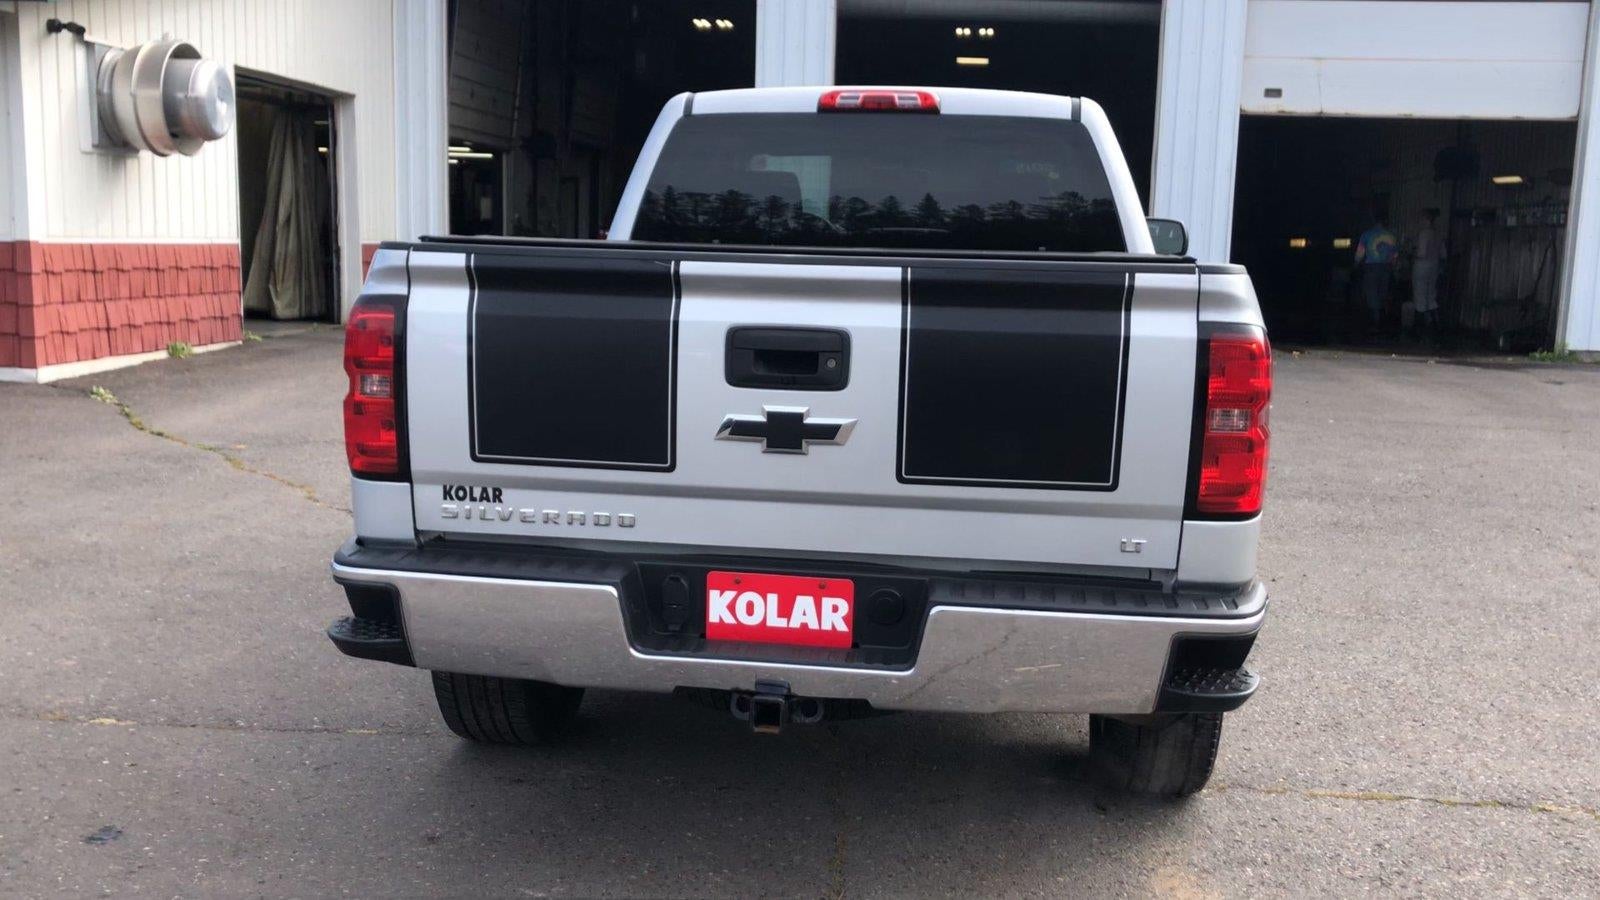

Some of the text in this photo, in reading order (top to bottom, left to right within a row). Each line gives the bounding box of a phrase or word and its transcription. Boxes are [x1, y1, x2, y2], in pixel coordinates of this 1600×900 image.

[442, 484, 503, 503] KOLAR
[441, 504, 636, 528] SILVERADO
[1120, 538, 1147, 554] LT
[708, 589, 849, 632] KOLAR
